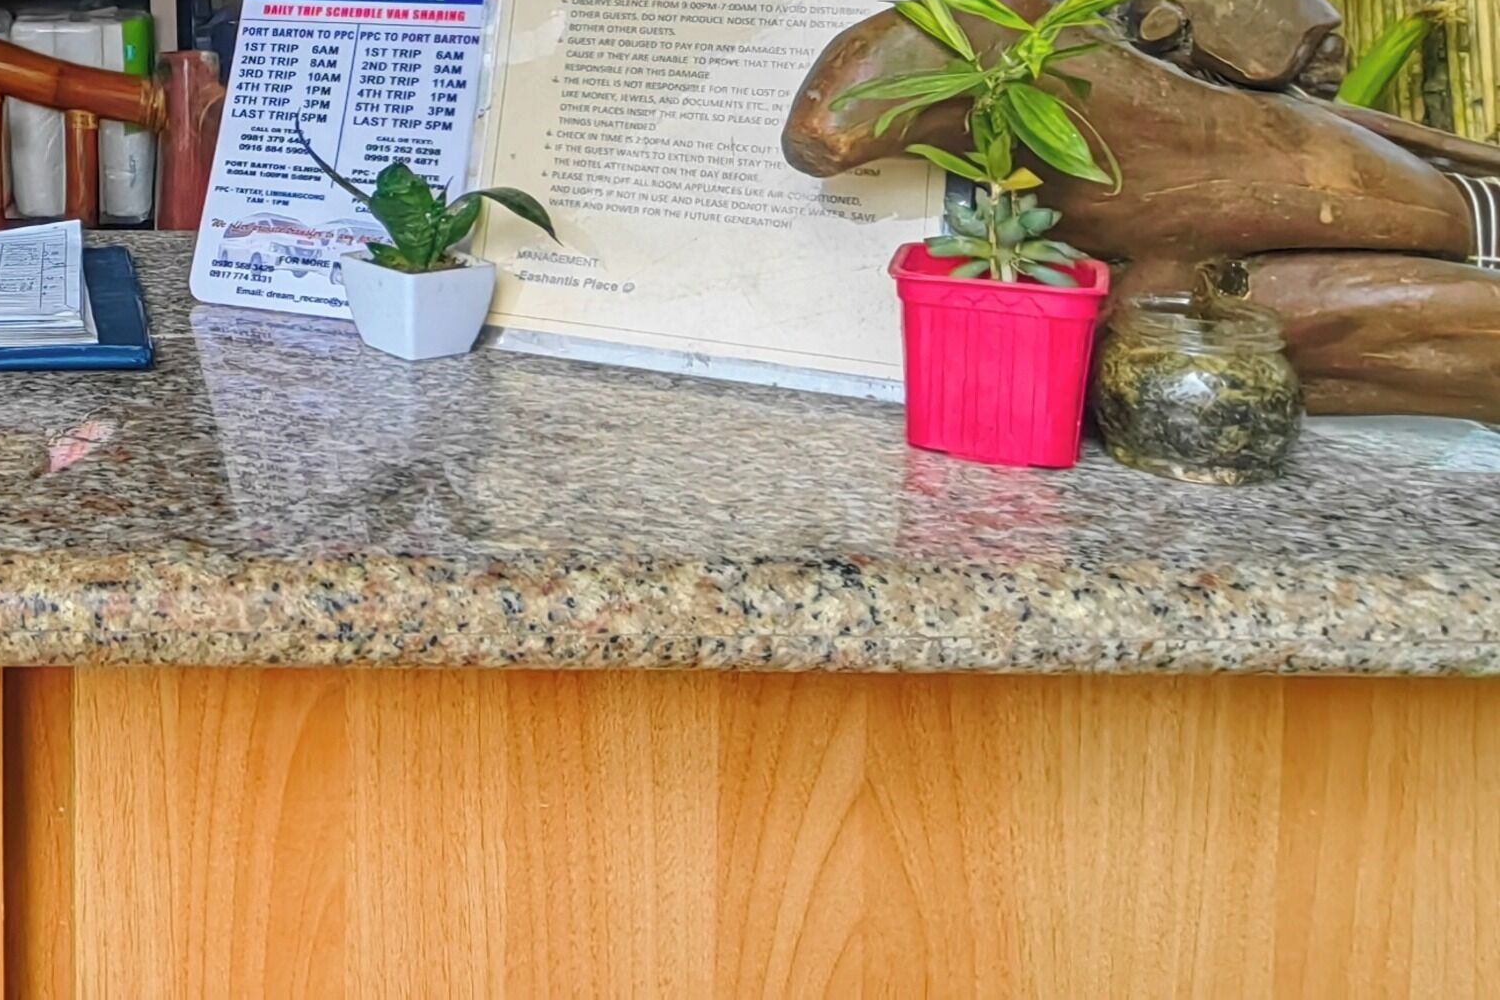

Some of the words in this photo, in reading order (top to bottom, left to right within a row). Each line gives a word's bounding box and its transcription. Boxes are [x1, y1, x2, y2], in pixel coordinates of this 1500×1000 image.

[263, 5, 294, 16] DAILY
[297, 6, 322, 17] TRIP
[326, 7, 383, 19] SCHEDULE
[386, 9, 409, 19] VAN
[413, 10, 465, 22] SHARING
[242, 27, 269, 36] PORT
[272, 28, 314, 38] BARTON
[318, 30, 331, 39] TO
[334, 30, 354, 40] PPC
[360, 31, 381, 40] PPC
[384, 32, 398, 41] TO
[401, 33, 431, 43] PORT
[434, 34, 480, 45] BARTON
[245, 43, 267, 52] 1ST
[270, 43, 299, 53] TRIP
[312, 45, 340, 55] 6AM
[365, 48, 388, 57] 1ST
[392, 48, 422, 59] TRIP
[436, 51, 464, 60] 6AM
[241, 56, 266, 65] 2ND
[270, 57, 299, 66] TRIP
[310, 59, 337, 68] 8AM
[361, 61, 387, 71] 2ND
[391, 62, 421, 72] TRIP
[434, 65, 462, 74] 9AM
[239, 69, 264, 78] 3RD
[268, 70, 297, 80] TRIP
[308, 72, 341, 82] 10AM
[359, 75, 385, 85] 3RD
[389, 76, 419, 86] TRIP
[432, 79, 467, 89] 11AM
[236, 82, 260, 92] 4TH
[264, 83, 293, 93] TRIP
[306, 86, 331, 95] 1PM
[234, 95, 257, 105] 5TH
[261, 96, 290, 107] TRIP
[303, 99, 330, 109] 3PM
[357, 89, 381, 99] 4TH
[385, 90, 416, 100] TRIP
[431, 92, 458, 102] 1PM
[231, 108, 265, 119] LAST
[268, 111, 297, 121] TRIP
[301, 113, 327, 123] 5PM
[355, 102, 379, 112] 5TH
[384, 104, 414, 114] TRIP
[428, 106, 456, 116] 3PM
[353, 116, 388, 127] LAST
[392, 118, 422, 129] TRIP
[424, 121, 453, 131] 5PM
[267, 135, 285, 143] 379
[250, 162, 286, 170] BARTON
[414, 157, 439, 166] 4871
[279, 256, 299, 265] FOR
[302, 258, 331, 268] MORE
[516, 250, 600, 268] MANAGEMENT
[233, 272, 249, 281] 774
[583, 277, 618, 292] Place
[236, 287, 264, 297] Email:
